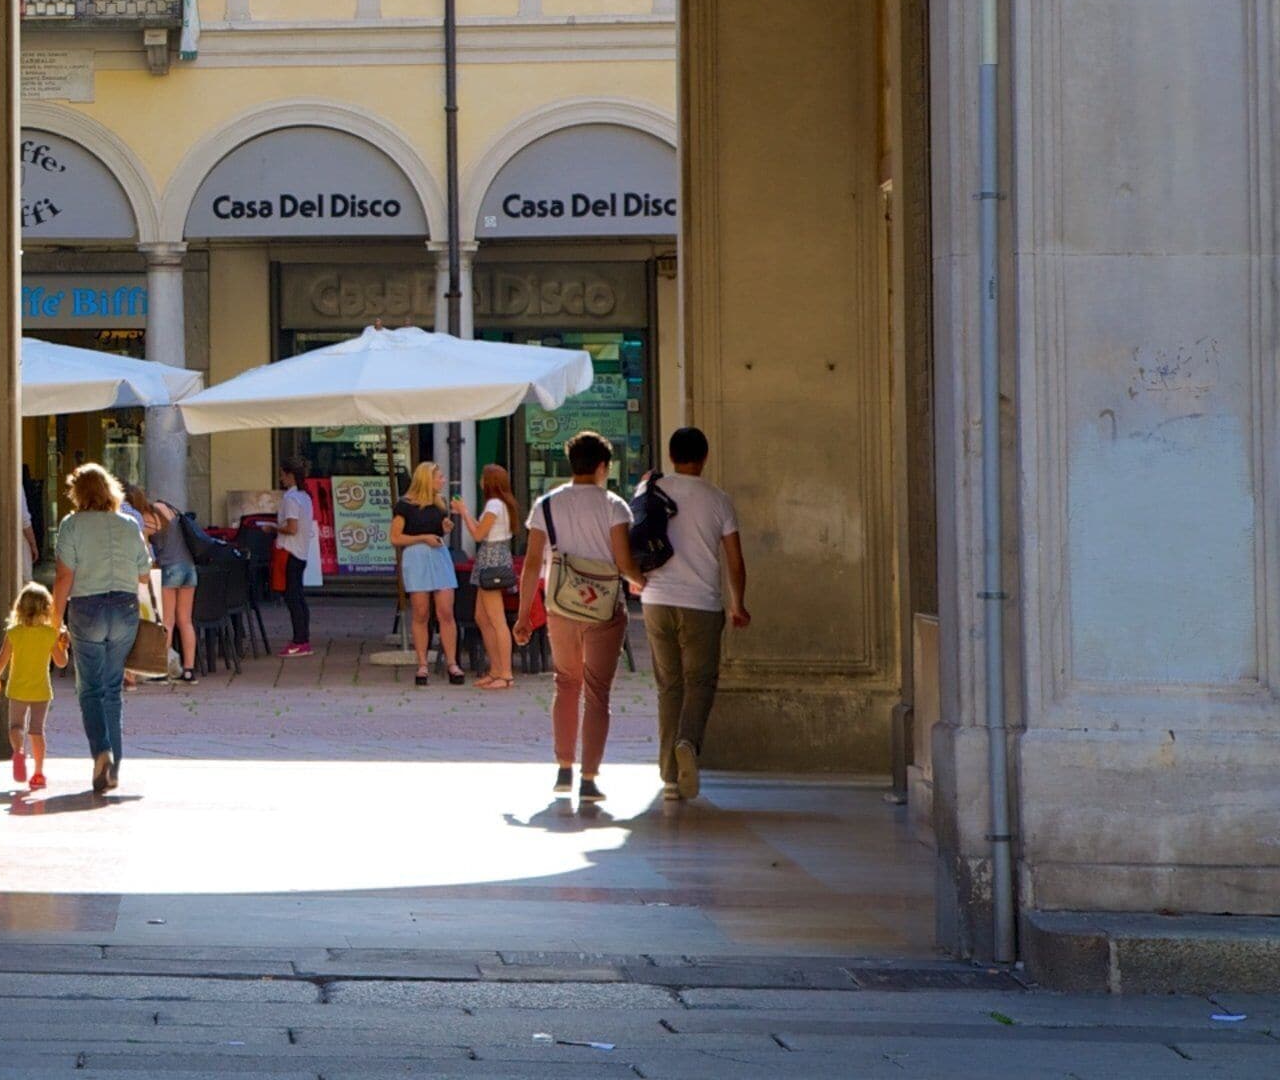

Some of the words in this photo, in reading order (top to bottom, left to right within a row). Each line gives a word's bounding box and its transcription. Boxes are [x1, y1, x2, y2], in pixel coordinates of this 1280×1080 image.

[213, 195, 273, 219] Casa
[280, 194, 324, 218] Del
[331, 194, 401, 218] Disco
[503, 194, 564, 218] Casa
[572, 193, 616, 217] Del
[624, 193, 677, 217] Disc
[72, 286, 149, 317] Biffi
[490, 273, 618, 317] Disco
[335, 484, 366, 505] 50
[340, 523, 388, 548] 50%
